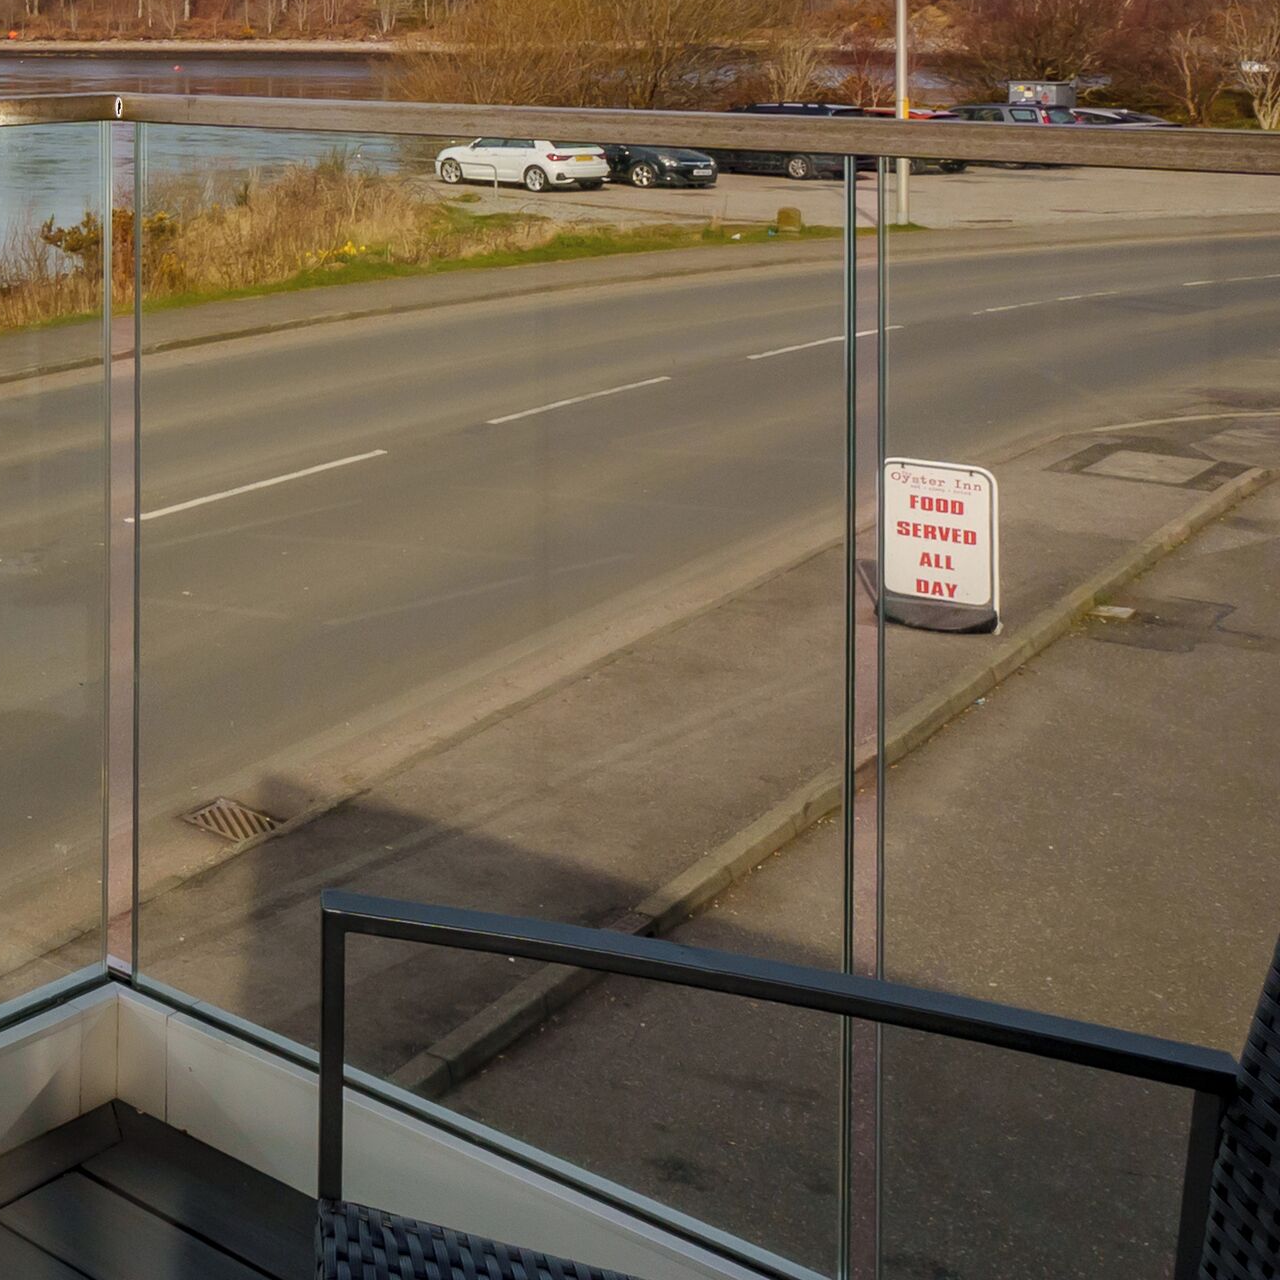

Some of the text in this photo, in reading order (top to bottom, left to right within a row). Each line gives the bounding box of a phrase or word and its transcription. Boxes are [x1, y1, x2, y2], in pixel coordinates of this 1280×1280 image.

[890, 471, 946, 487] Oyster
[954, 479, 982, 492] Inn
[909, 494, 964, 516] FOOD
[896, 520, 977, 546] SERVED
[919, 551, 955, 571] ALL
[916, 578, 958, 599] DAY
